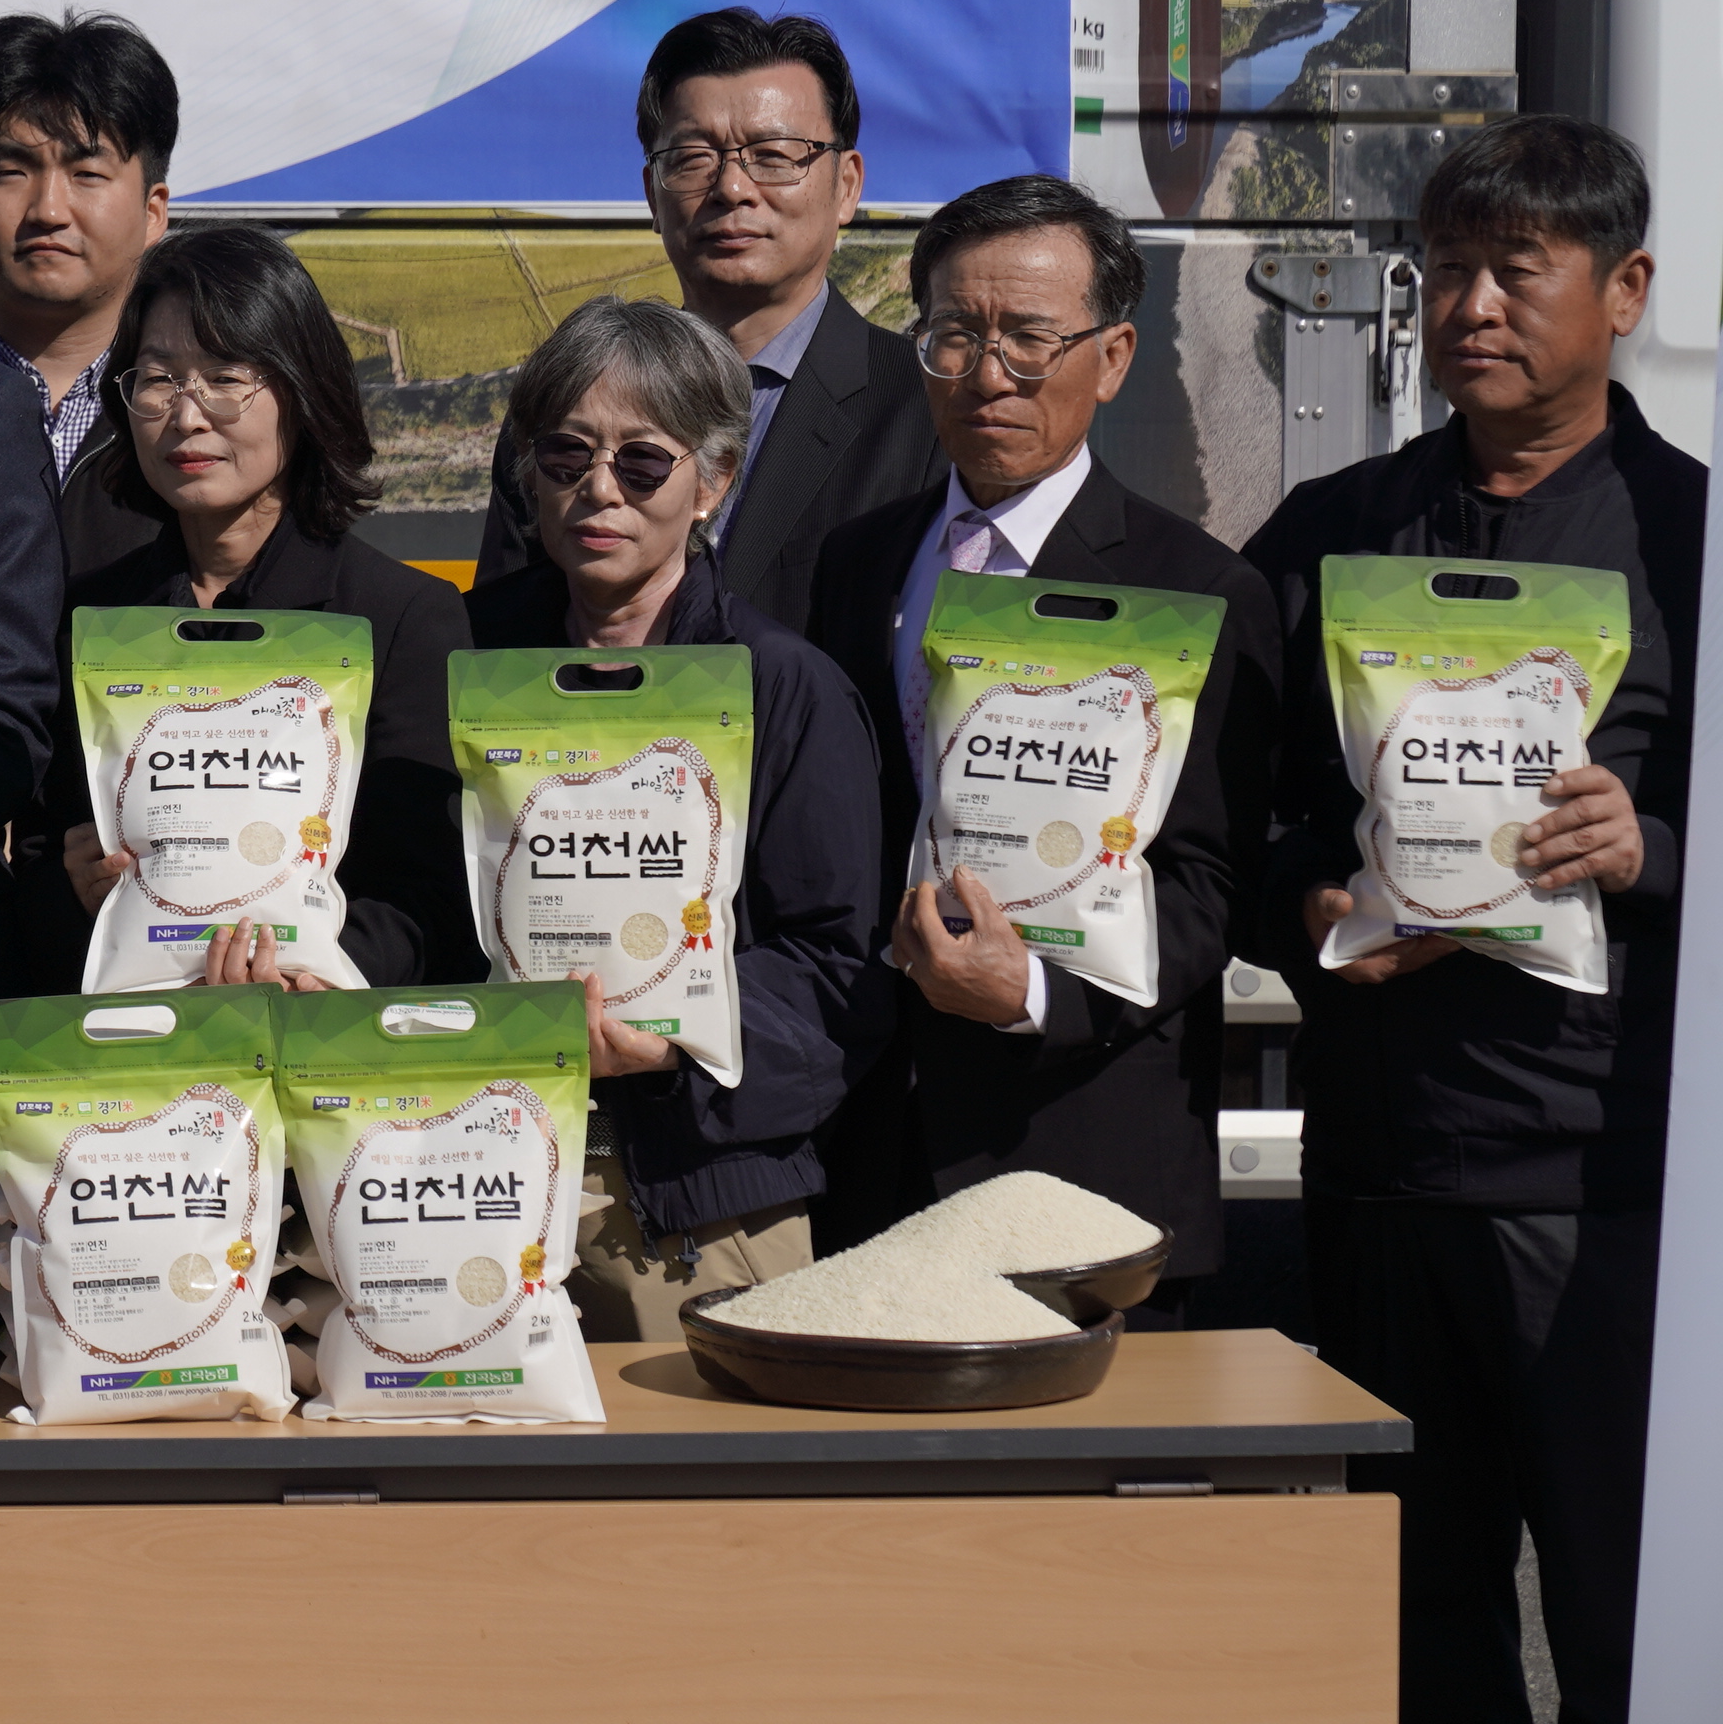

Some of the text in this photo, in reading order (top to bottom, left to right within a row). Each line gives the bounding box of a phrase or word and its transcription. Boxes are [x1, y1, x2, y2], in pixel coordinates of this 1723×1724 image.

[1083, 18, 1104, 40] kg
[964, 734, 1119, 792] 연천쌀
[1402, 738, 1563, 789] 연천쌀
[148, 749, 305, 794] 연천쌀
[540, 809, 558, 820] 매일
[562, 809, 582, 820] 먹고
[608, 809, 636, 820] 신선한
[529, 831, 687, 880] 연천쌀
[157, 928, 178, 938] NH
[1029, 927, 1076, 944] 전곡농협
[690, 969, 711, 981] 2 kg
[70, 1171, 230, 1225] 연천쌀
[359, 1171, 524, 1225] 연천쌀
[243, 1311, 264, 1325] 2 kg
[531, 1315, 551, 1328] 2 kg
[179, 1367, 229, 1382] 전곡농협
[374, 1375, 398, 1386] NH
[464, 1368, 514, 1385] 전곡농협
[90, 1377, 113, 1389] NH
[396, 1390, 414, 1400] (031)
[415, 1389, 447, 1399] 832-2098
